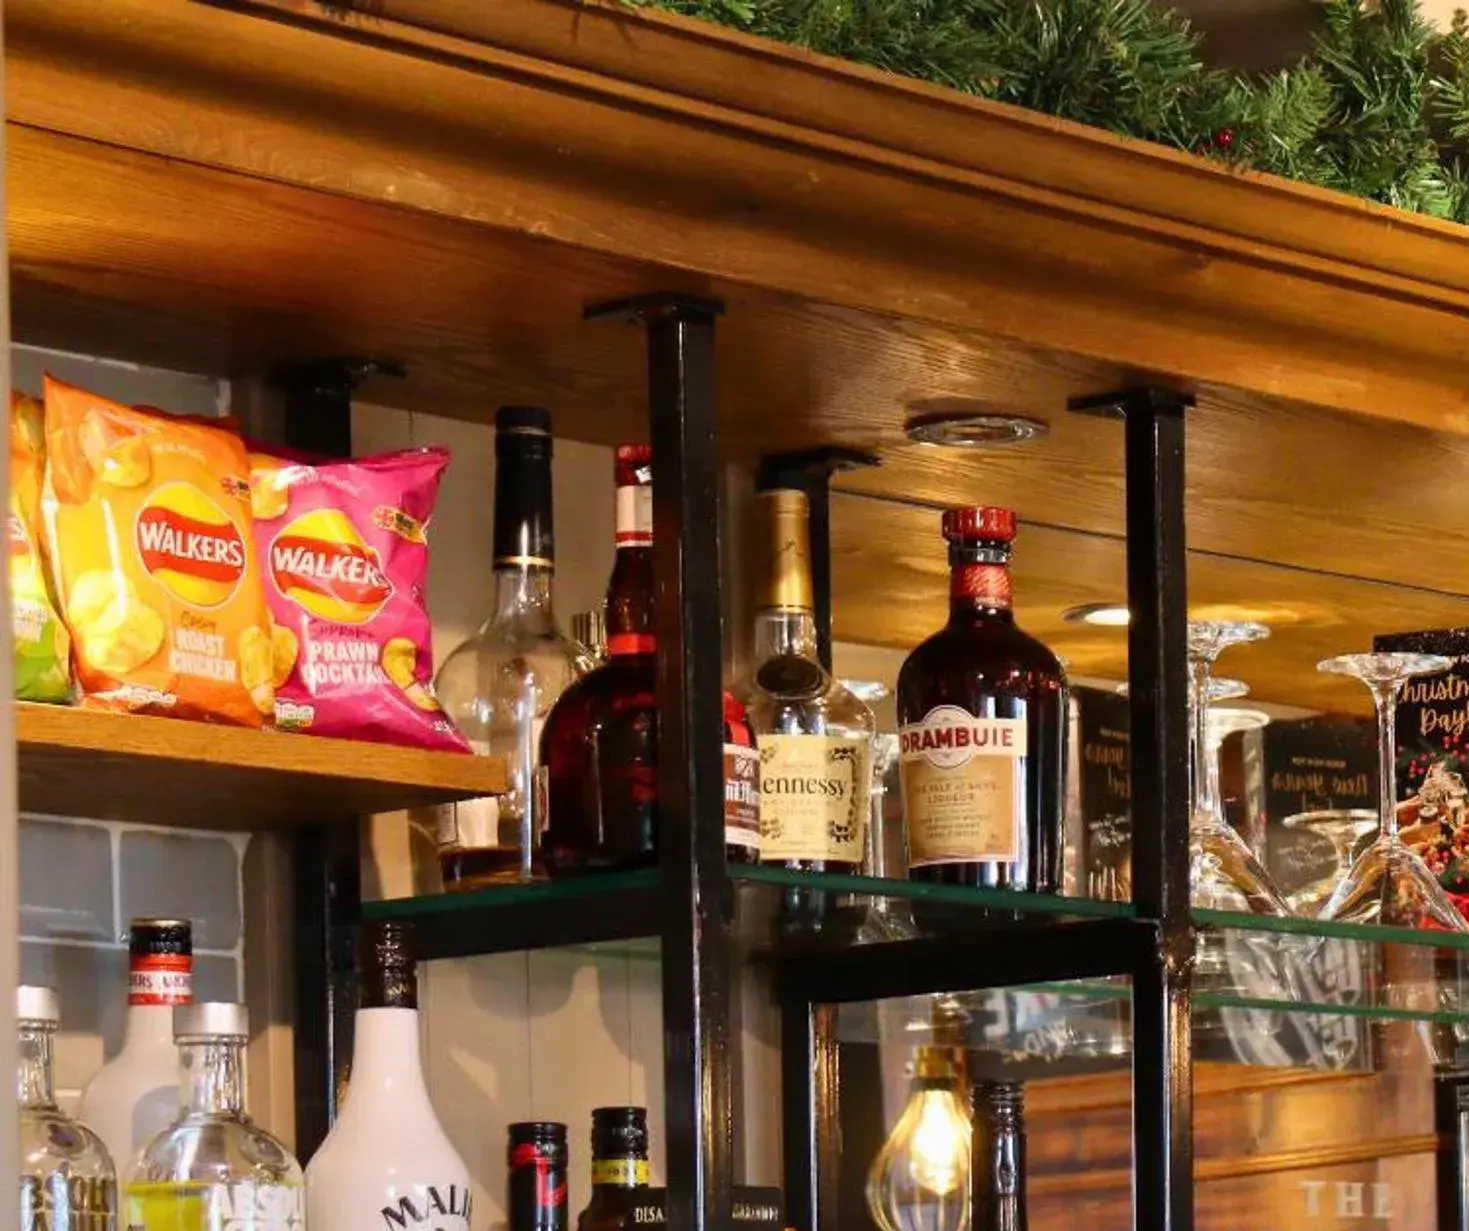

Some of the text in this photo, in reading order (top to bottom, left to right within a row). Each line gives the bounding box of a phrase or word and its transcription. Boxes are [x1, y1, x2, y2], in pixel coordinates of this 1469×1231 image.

[139, 520, 244, 567] WALKERS
[175, 628, 226, 656] ROAST
[306, 640, 379, 663] PRAWN
[902, 726, 1014, 753] DRAMBUIE
[762, 776, 847, 799] ennessy
[1300, 1180, 1394, 1218] THE
